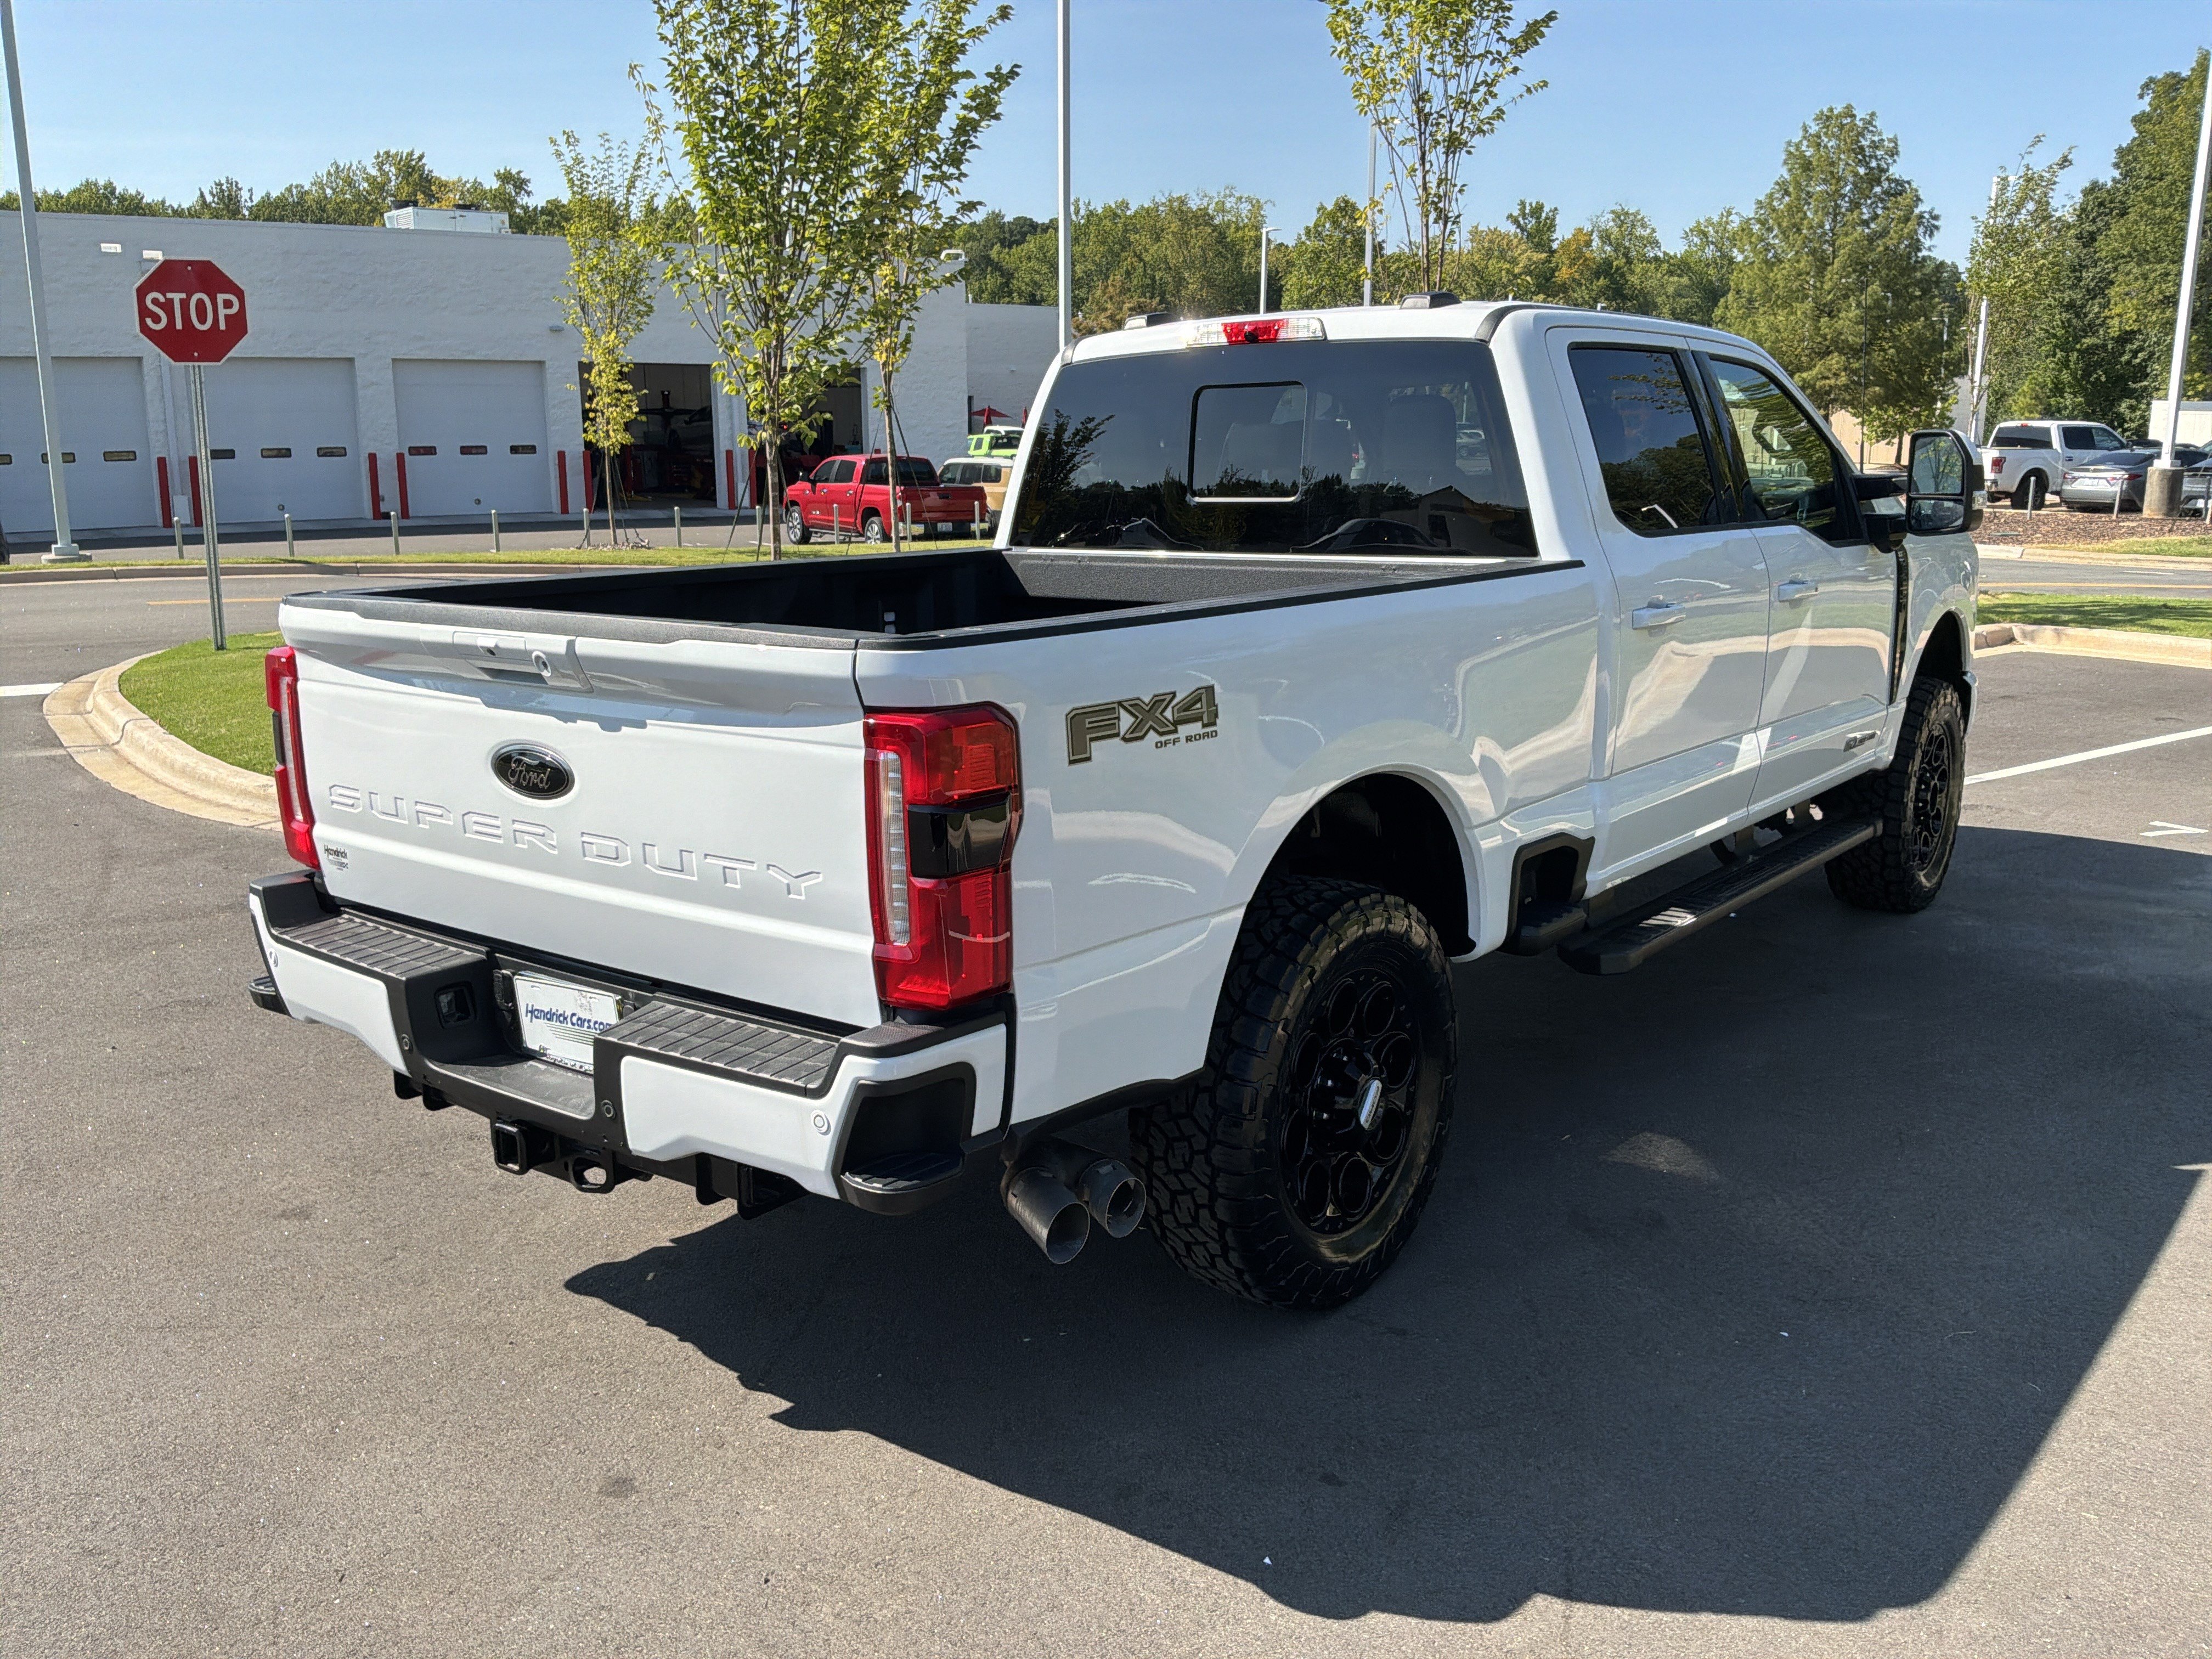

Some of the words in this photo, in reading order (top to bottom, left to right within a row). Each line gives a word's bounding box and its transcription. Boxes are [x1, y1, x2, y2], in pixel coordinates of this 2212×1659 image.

[145, 291, 240, 331] STOP
[1065, 684, 1218, 766] FX4
[1155, 737, 1181, 749] OFF
[1185, 730, 1218, 744] ROAD
[507, 755, 551, 790] Ford
[324, 844, 348, 860] Hendrick
[329, 783, 558, 855] SUPER
[580, 831, 822, 900] DUTY
